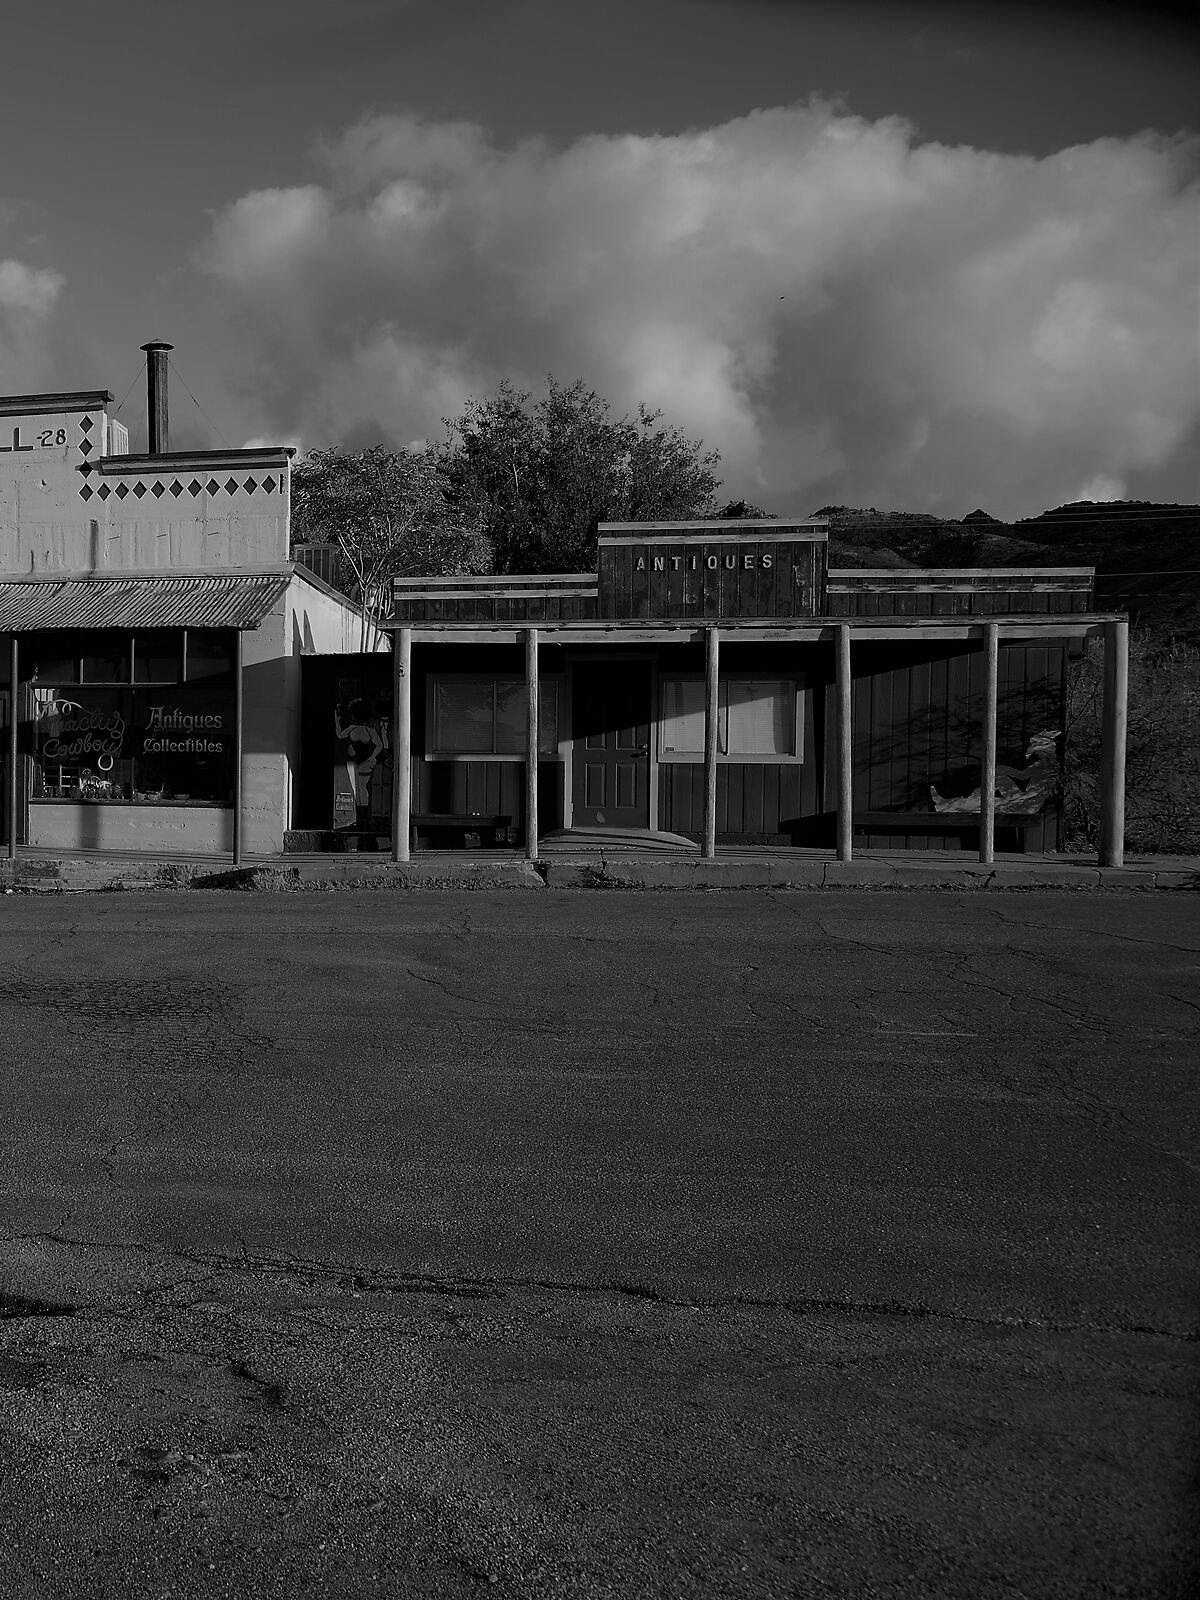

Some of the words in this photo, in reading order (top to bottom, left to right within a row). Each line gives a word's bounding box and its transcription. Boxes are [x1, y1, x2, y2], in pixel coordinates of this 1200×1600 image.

[636, 554, 773, 571] ANTIQUES
[43, 731, 123, 771] Cowboy
[141, 738, 223, 755] Collectibles
